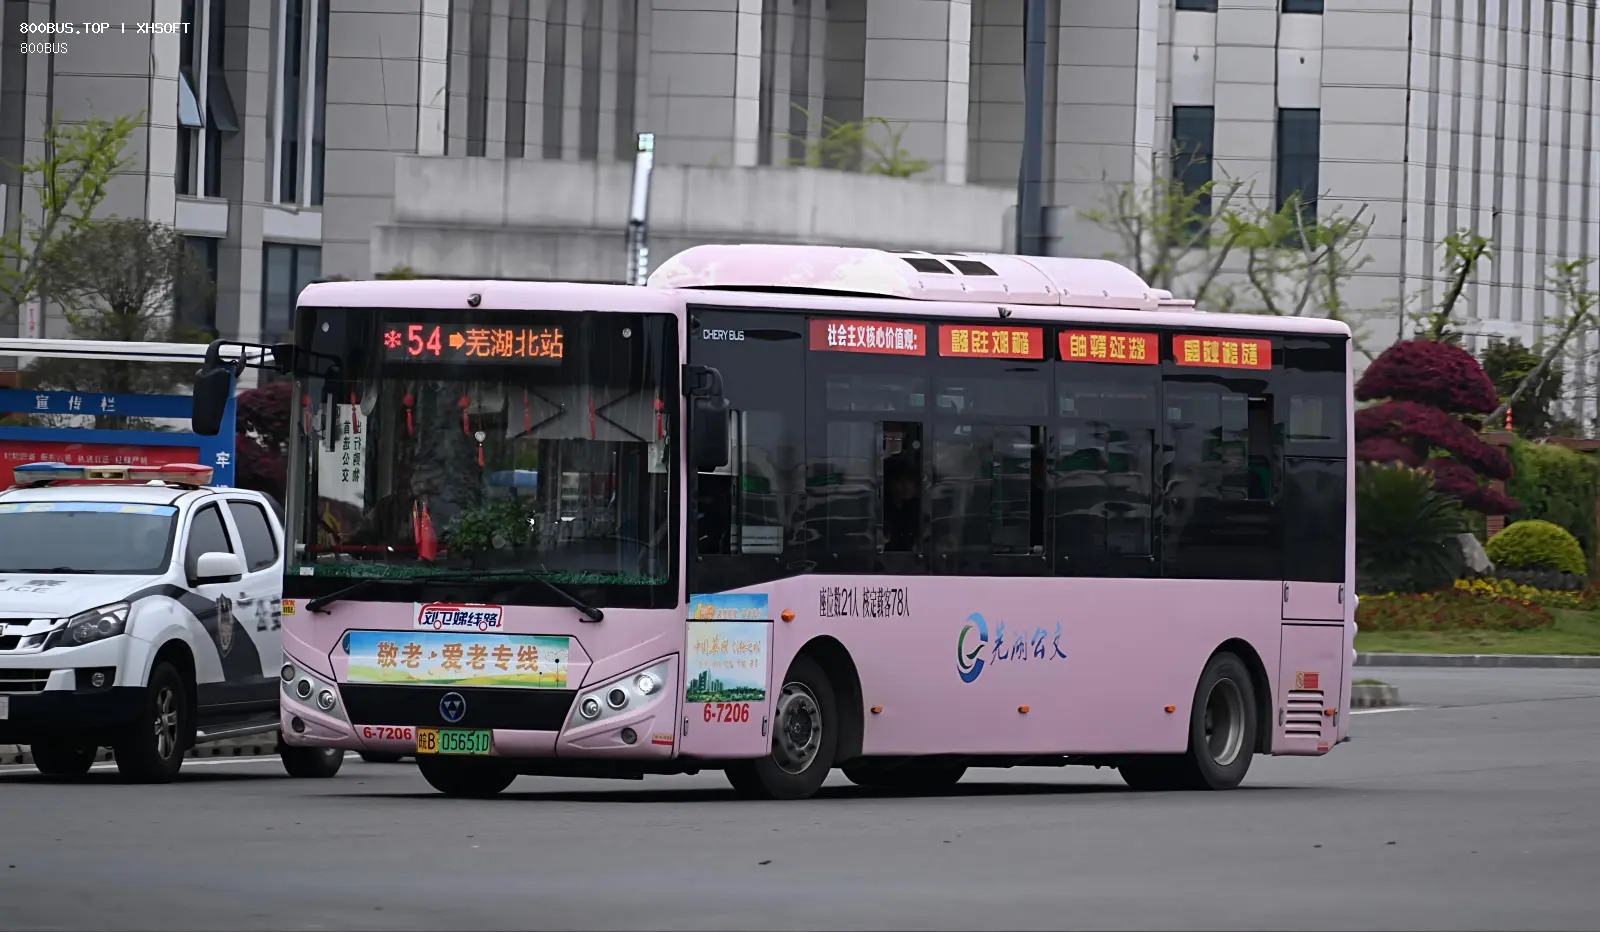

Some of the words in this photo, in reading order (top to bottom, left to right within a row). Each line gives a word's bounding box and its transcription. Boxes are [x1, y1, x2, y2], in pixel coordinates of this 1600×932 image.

[408, 325, 442, 357] 54
[465, 328, 564, 359] 芜湖北站
[702, 329, 728, 341] CHERY
[729, 330, 745, 341] BUS
[951, 329, 969, 353] 富强
[971, 330, 989, 353] 民主
[992, 330, 1009, 354] 文明
[1012, 331, 1029, 355] 和谐
[1070, 334, 1087, 357] 自由
[1090, 335, 1107, 358] 平等
[1109, 336, 1126, 359] 公正
[1128, 337, 1146, 360] 法治
[1184, 339, 1200, 362] 爱国
[1222, 341, 1239, 365] 诚信
[1241, 342, 1258, 366] 友善
[35, 395, 116, 413] 宣传栏
[819, 586, 860, 618] 座位数21人
[862, 586, 911, 619] 核定载客78人
[989, 619, 1068, 666] 芜湖公交
[440, 641, 540, 673] 爱老专线
[703, 703, 750, 723] 6-7206
[362, 725, 413, 742] 6-7206
